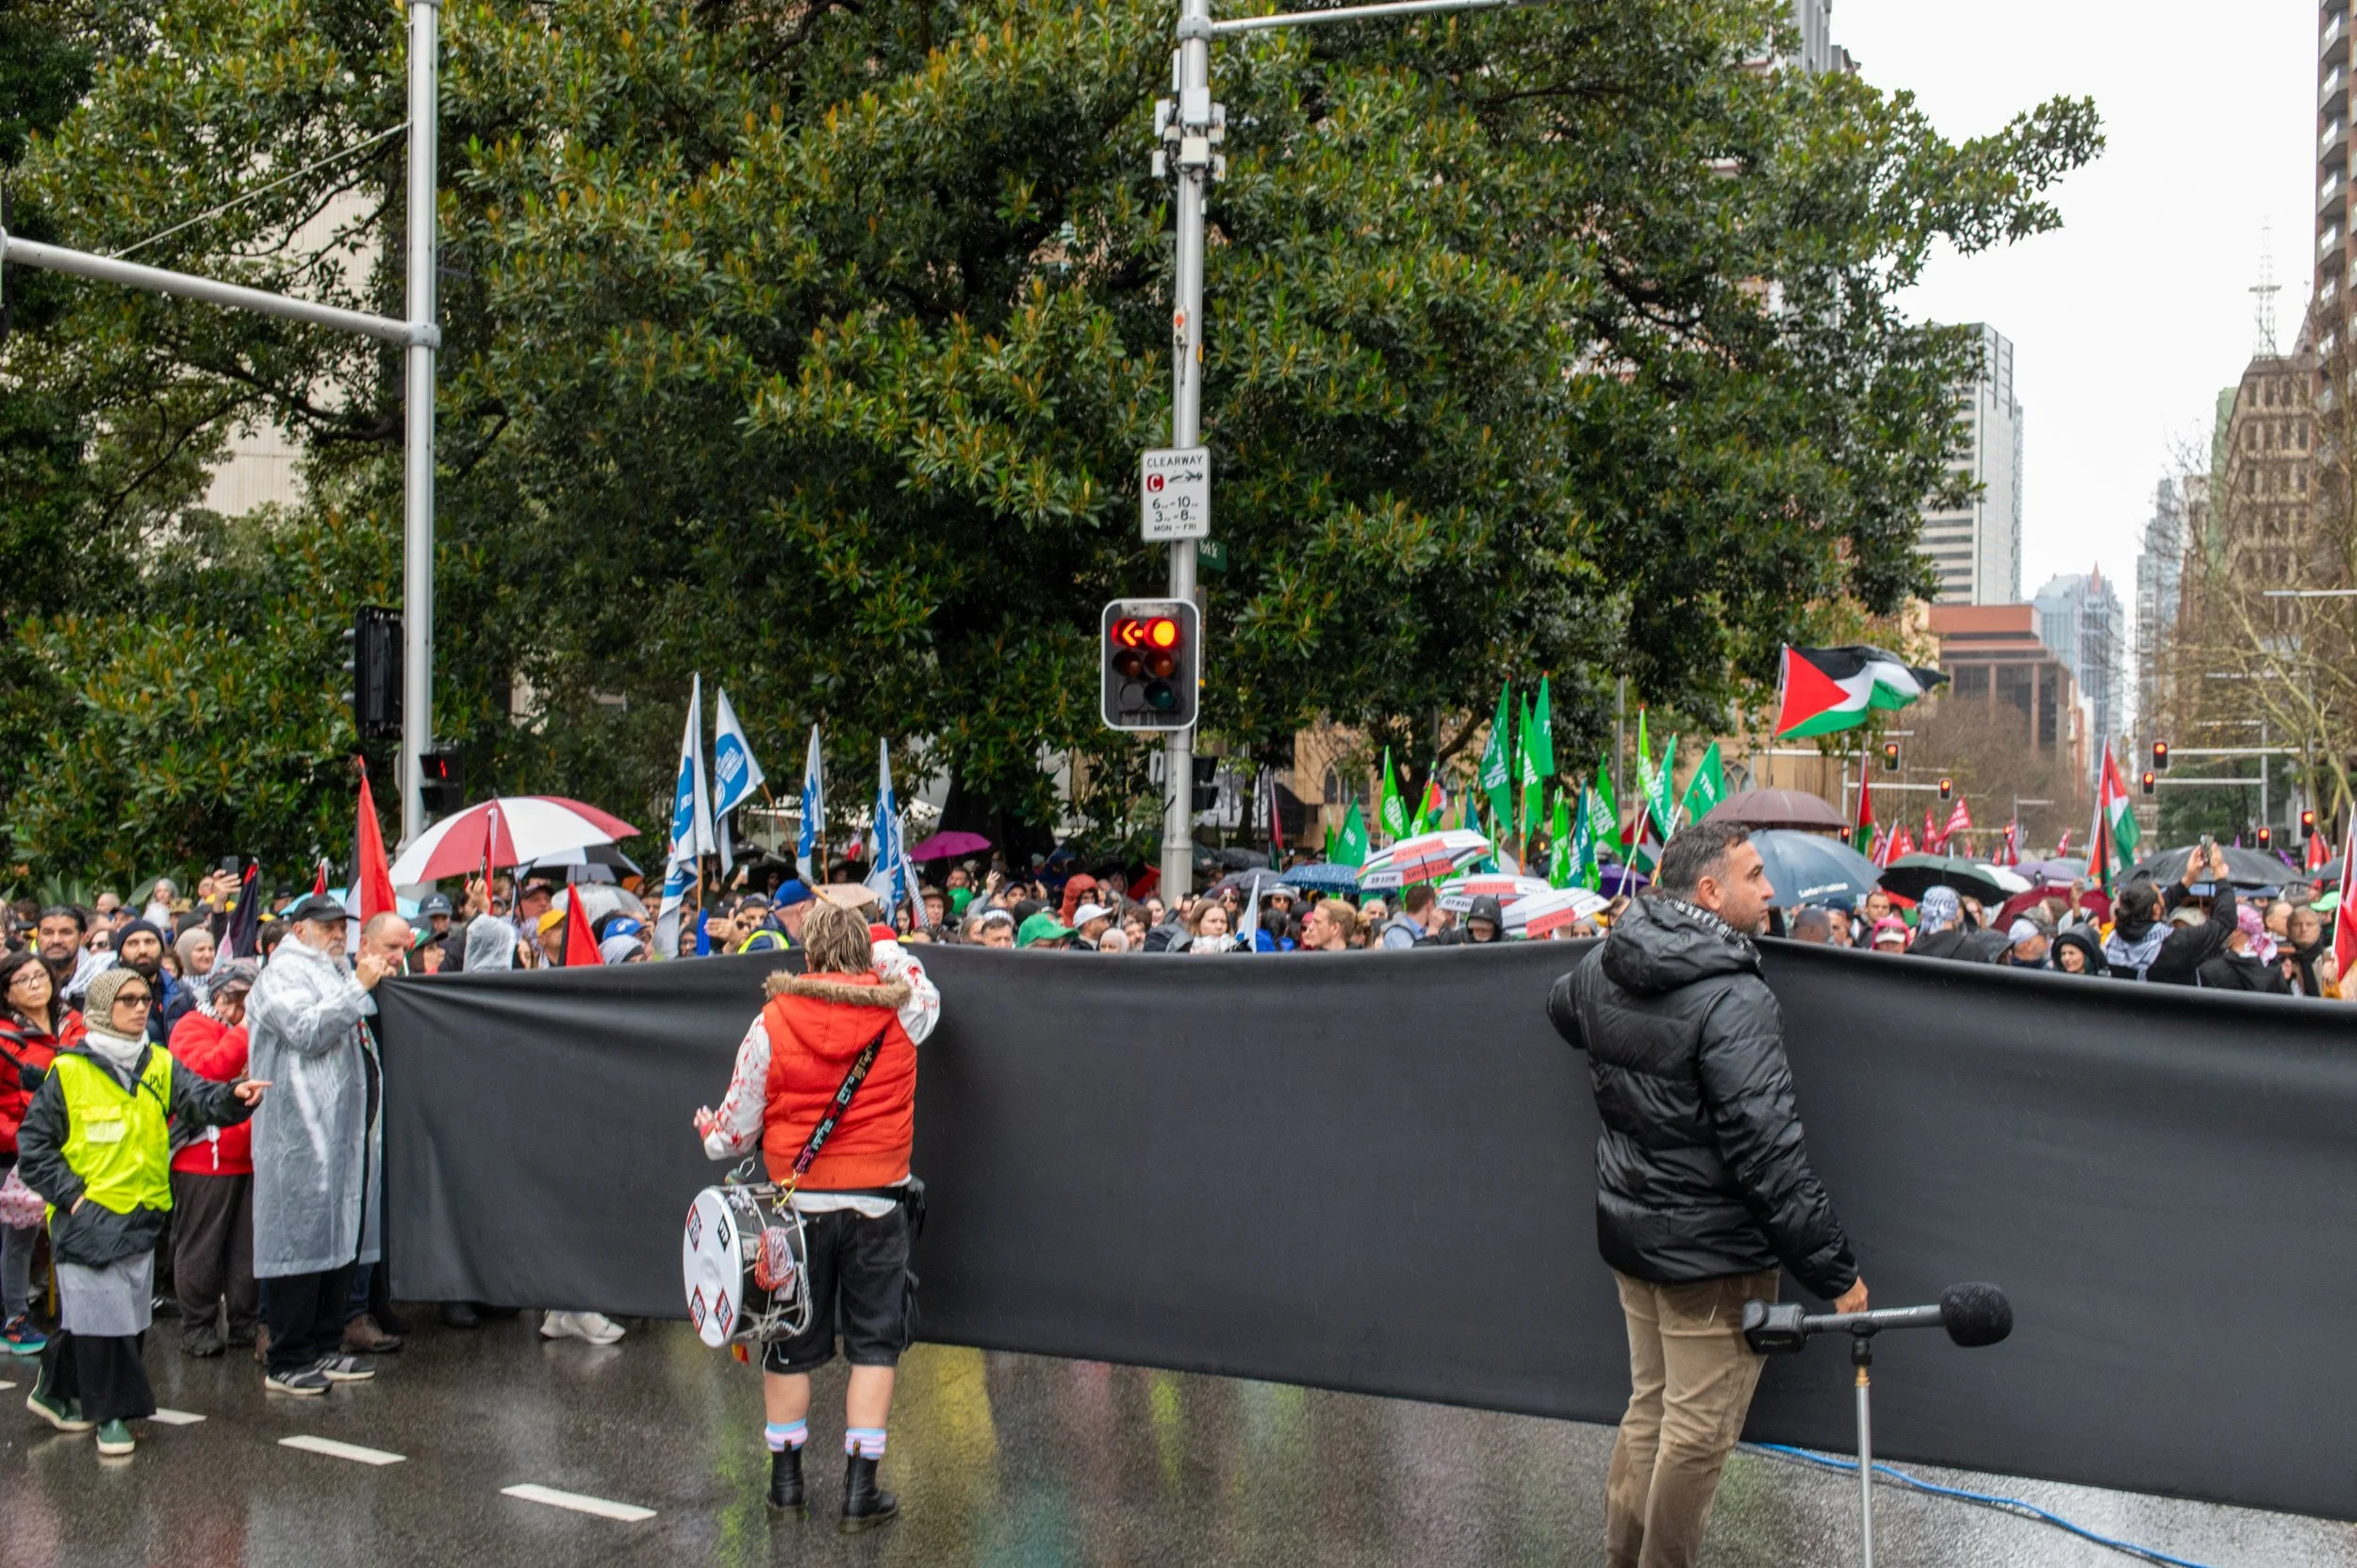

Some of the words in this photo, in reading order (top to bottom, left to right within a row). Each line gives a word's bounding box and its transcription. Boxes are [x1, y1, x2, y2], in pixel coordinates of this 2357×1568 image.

[1147, 455, 1202, 468] CLEARWAY
[1149, 474, 1161, 492] C
[1183, 522, 1196, 531] FRI
